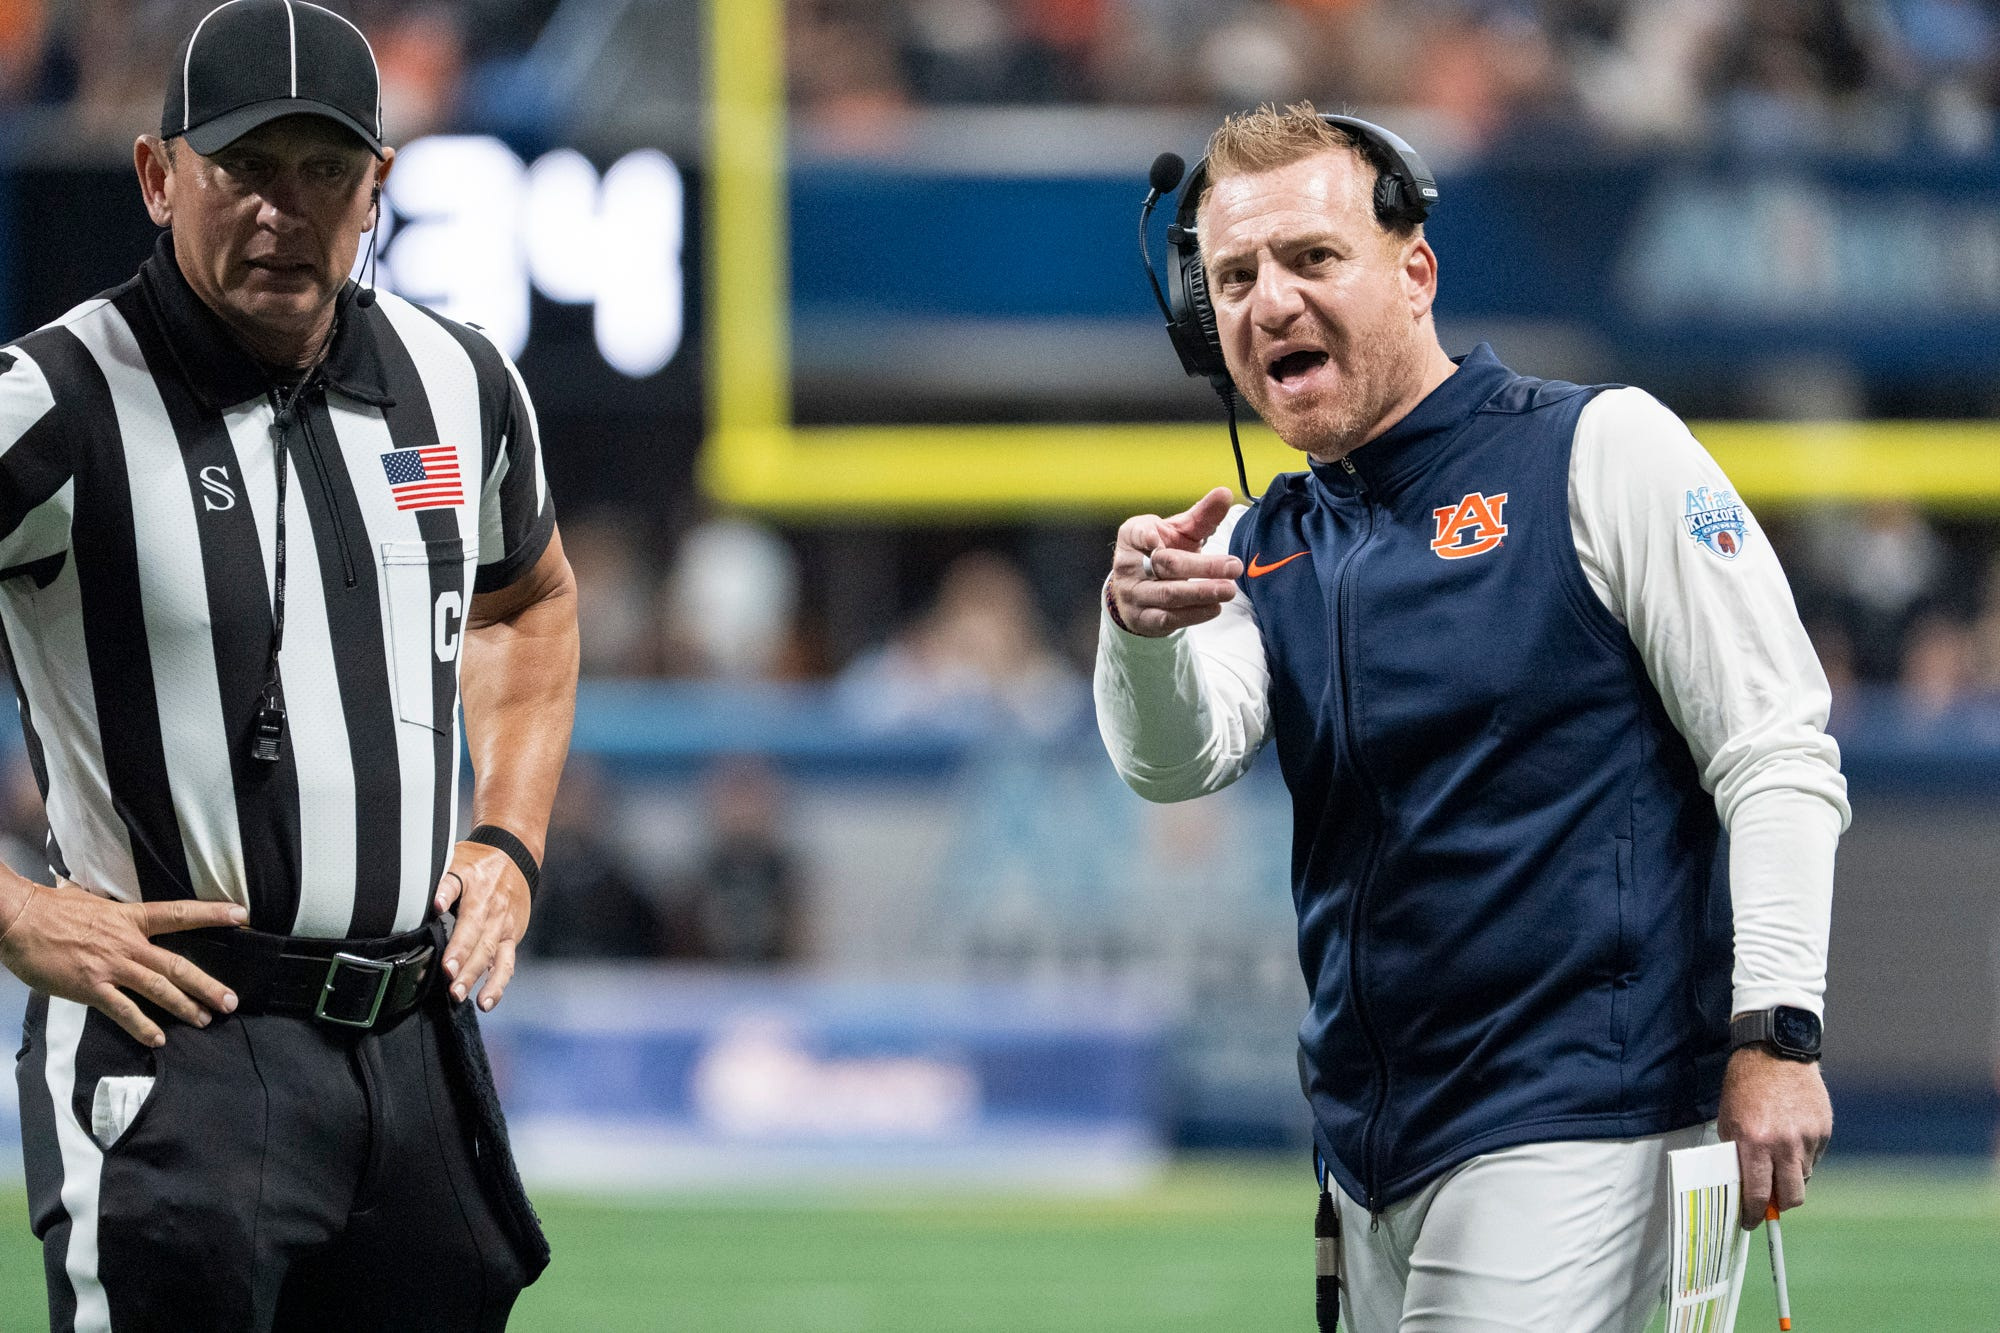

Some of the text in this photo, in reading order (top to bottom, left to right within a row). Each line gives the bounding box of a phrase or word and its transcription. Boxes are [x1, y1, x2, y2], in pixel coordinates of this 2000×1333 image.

[199, 465, 236, 512] S
[1686, 486, 1736, 514] Aflac
[1686, 506, 1744, 532] KICKOFF
[434, 590, 462, 663] C
